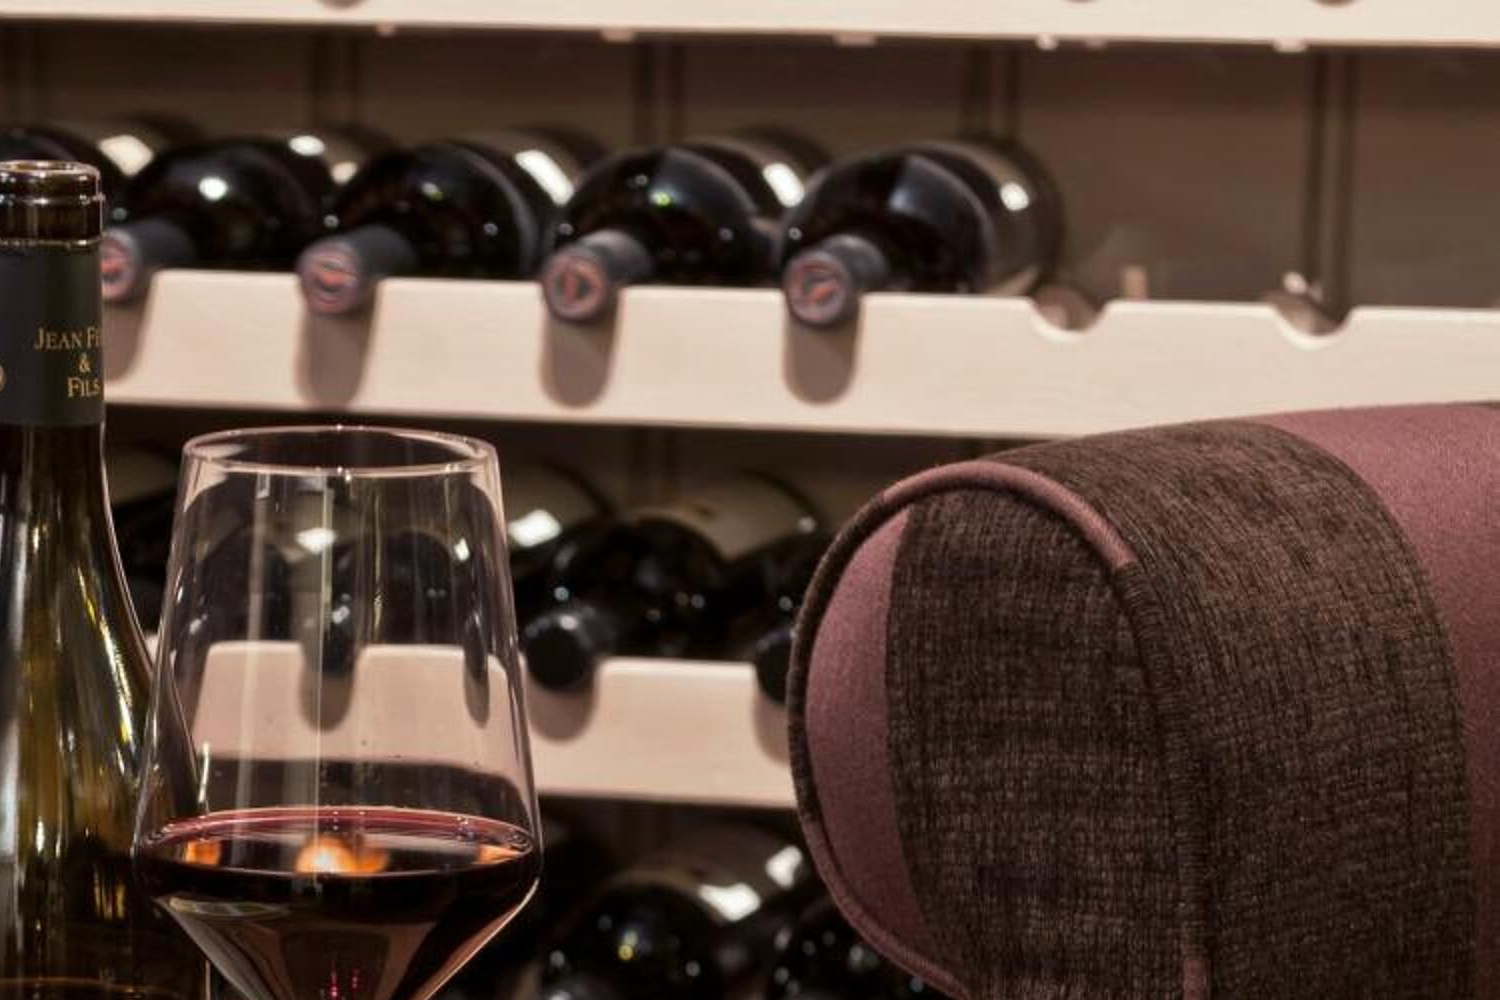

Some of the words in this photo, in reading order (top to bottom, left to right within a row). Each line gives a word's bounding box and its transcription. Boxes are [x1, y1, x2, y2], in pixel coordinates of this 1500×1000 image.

[34, 327, 83, 349] JEAN
[77, 352, 91, 373] &
[67, 377, 100, 398] FILS
